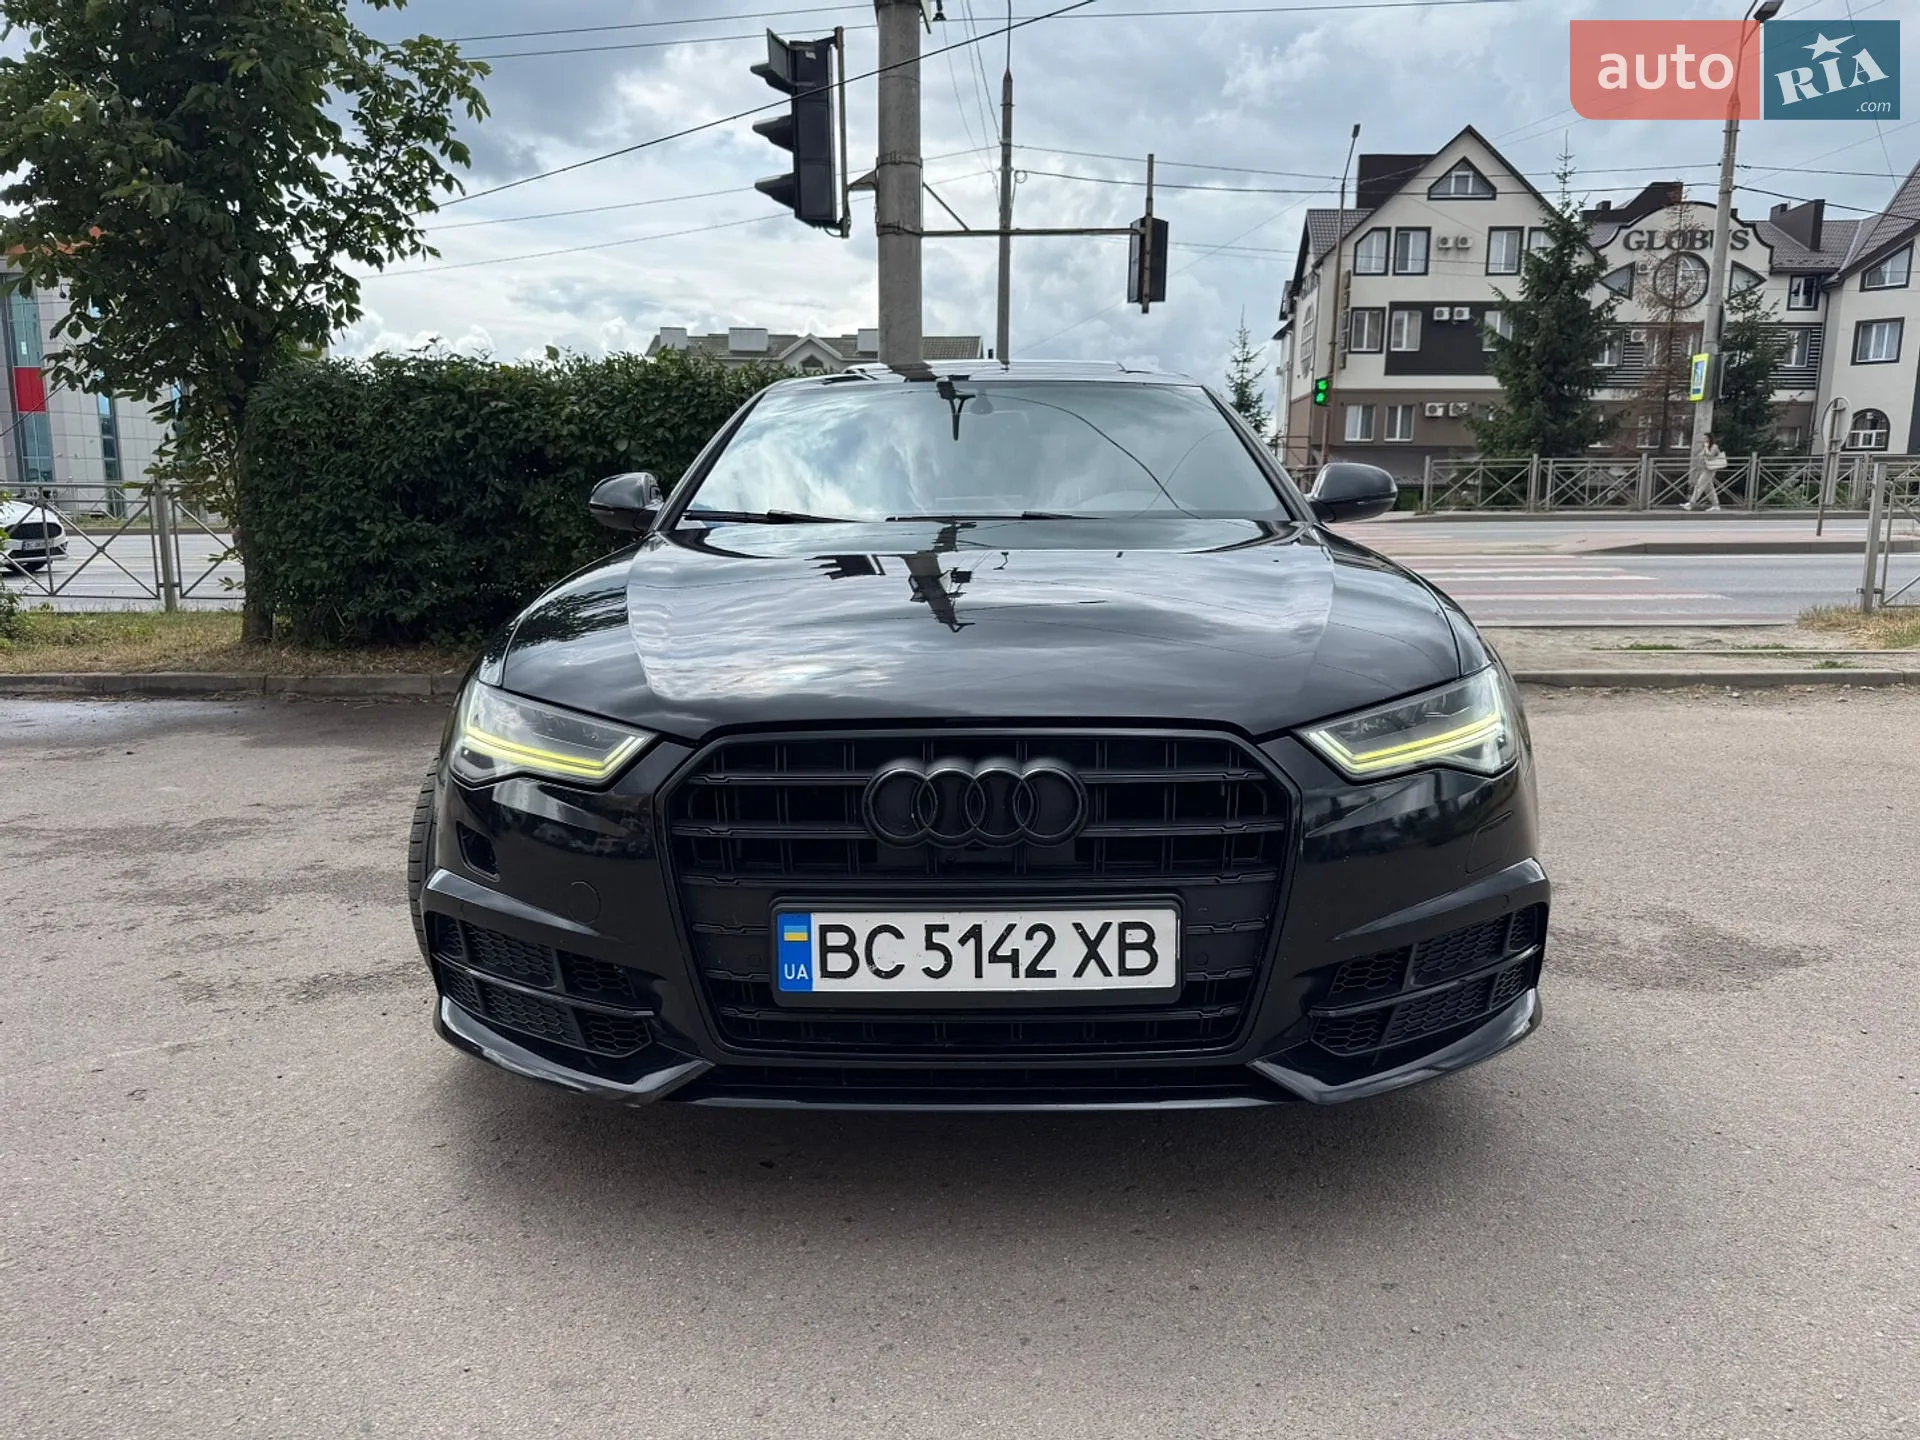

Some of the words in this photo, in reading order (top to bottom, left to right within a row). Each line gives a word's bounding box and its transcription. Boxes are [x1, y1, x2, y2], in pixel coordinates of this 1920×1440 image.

[818, 924, 905, 979] BC
[921, 923, 1057, 979] 5142
[1072, 921, 1159, 978] XB
[784, 964, 808, 980] UA
